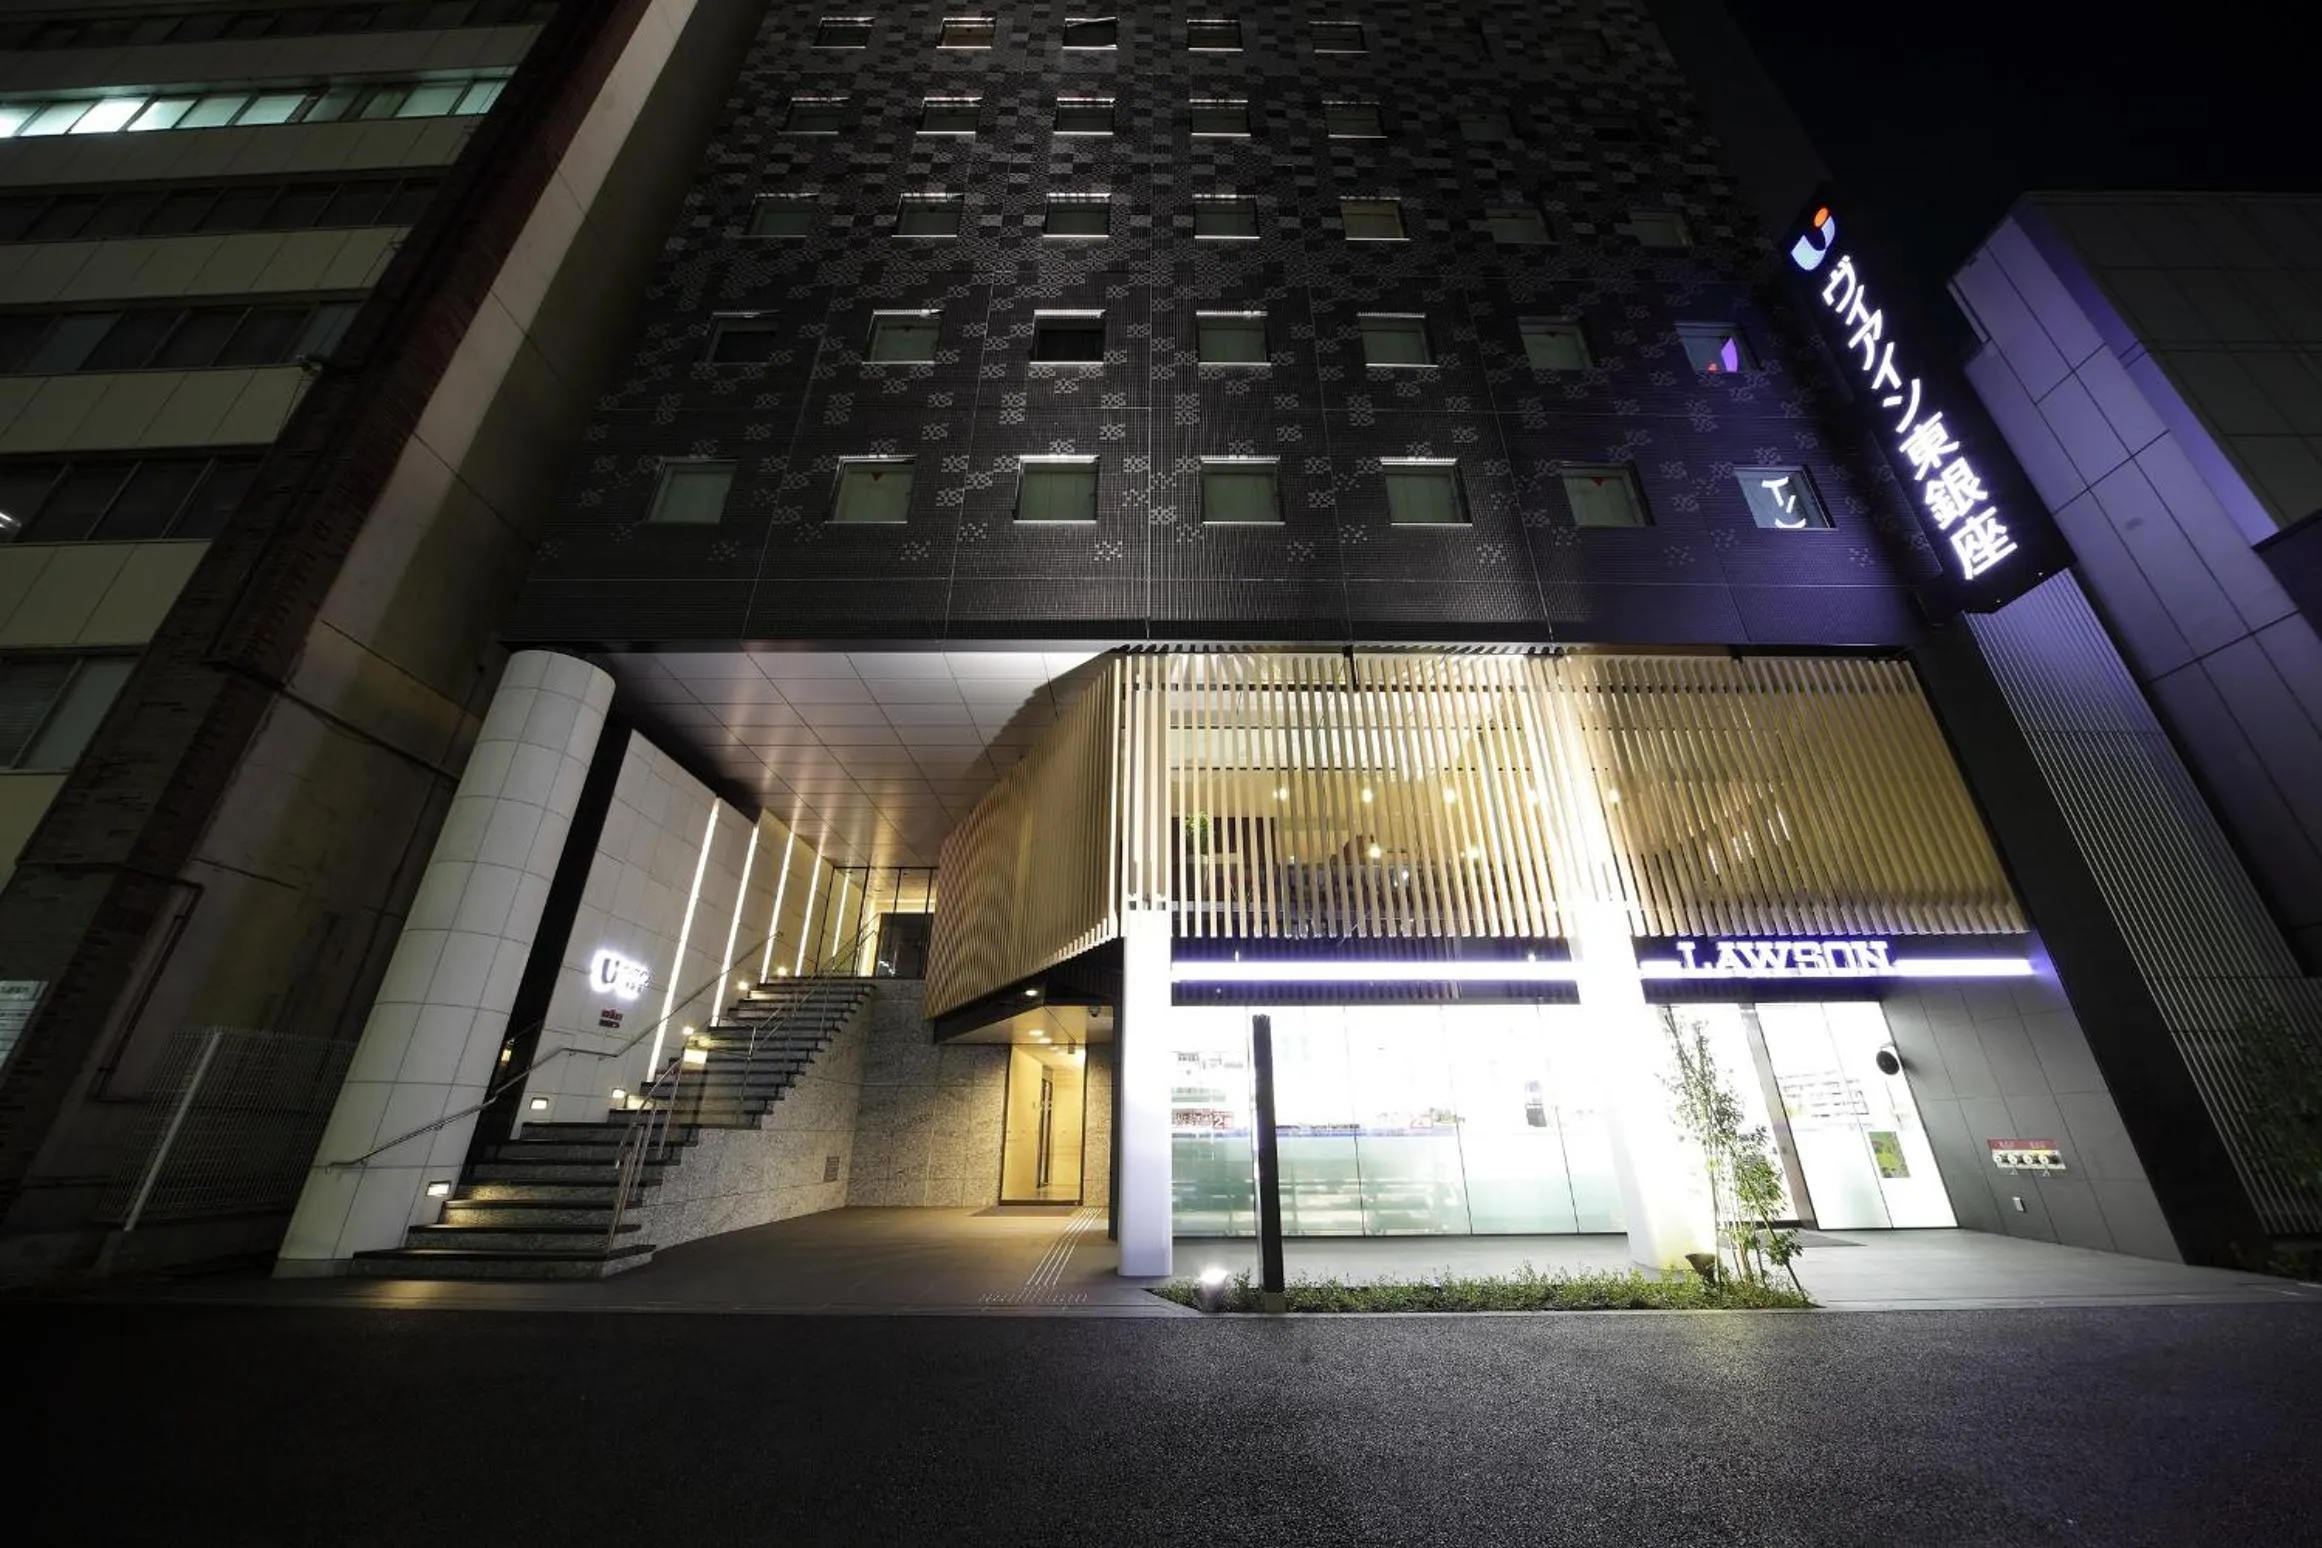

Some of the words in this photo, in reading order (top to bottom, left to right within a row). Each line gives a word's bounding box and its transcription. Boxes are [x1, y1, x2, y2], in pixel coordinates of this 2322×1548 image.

[1823, 255, 2017, 580] ヴィアイン東銀座
[1676, 940, 1892, 977] LAWSON
